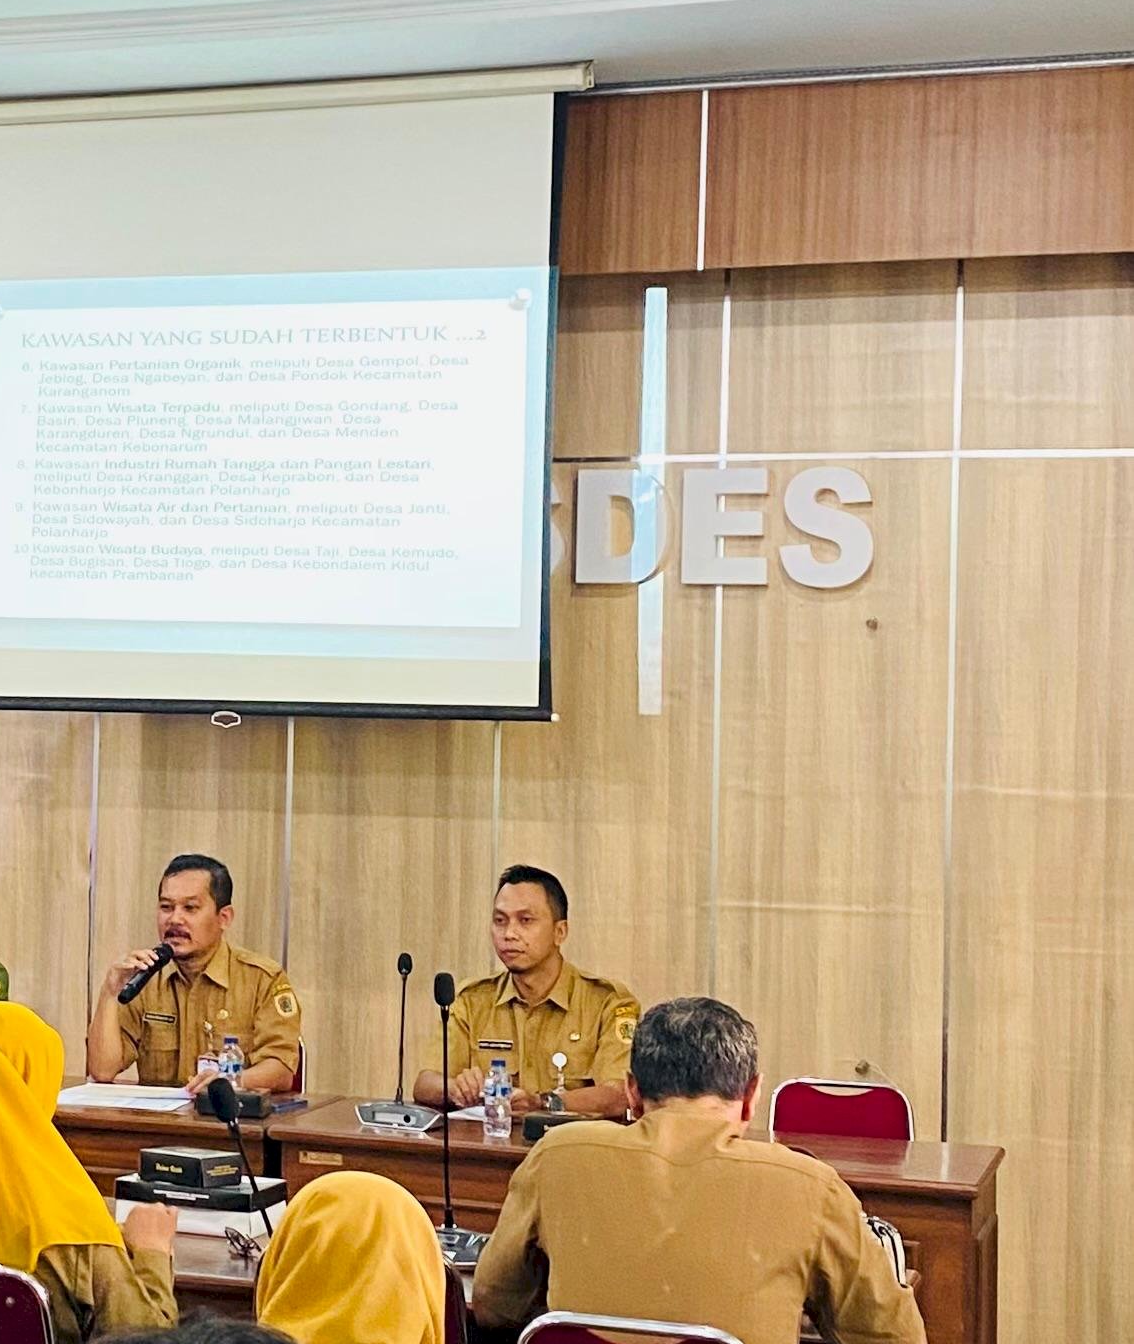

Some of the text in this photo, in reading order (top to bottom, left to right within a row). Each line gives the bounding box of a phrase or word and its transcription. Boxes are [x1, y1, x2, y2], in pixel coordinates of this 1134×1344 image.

[22, 332, 132, 348] KAWASAN
[139, 331, 202, 346] YANG
[210, 329, 293, 345] SUDAH
[300, 326, 447, 343] TERBENTUK
[40, 360, 103, 371] Kawasan
[109, 359, 179, 370] Pertanian
[250, 357, 310, 369] meliputi
[316, 357, 353, 368] Desa
[430, 355, 468, 366] Desa
[93, 373, 128, 383] Desa
[216, 372, 242, 382] dan
[249, 371, 285, 381] Desa
[292, 370, 347, 381] Pondok
[354, 369, 442, 380] Kecamatan
[38, 387, 130, 398] Karanganom
[38, 403, 101, 413] Kawasan
[107, 402, 155, 413] Wisata
[230, 401, 289, 413] meliputi
[295, 401, 332, 411] Desa
[419, 400, 458, 410] Desa
[86, 415, 121, 425] Desa
[196, 415, 232, 425] Desa
[343, 414, 380, 424] Desa
[140, 428, 175, 438] Desa
[258, 427, 285, 438] dan
[292, 427, 329, 438] Desa
[336, 427, 398, 438] Menden
[36, 442, 207, 453] Kecamatan Kebonarum
[35, 459, 99, 469] Kawasan
[105, 459, 159, 469] Industri
[165, 459, 216, 469] Rumah
[224, 459, 274, 471] Tangga
[281, 459, 308, 469] dan
[314, 459, 371, 471] Pangan
[34, 472, 91, 484] meliputi
[97, 472, 132, 482] Desa
[219, 472, 255, 482] Desa
[346, 472, 373, 482] dan
[380, 472, 419, 483] Desa
[34, 485, 290, 497] Kebonharjo Kecamatan Polanharjo
[33, 502, 97, 512] Kawasan
[103, 502, 152, 512] Wisata
[157, 502, 175, 512] Air
[181, 502, 207, 512] dan
[296, 503, 357, 515] meliputi
[364, 503, 402, 514] Desa
[33, 515, 67, 525] Desa
[159, 515, 186, 526] dan
[193, 516, 228, 526] Desa
[235, 516, 306, 528] Sidoharjo
[312, 516, 400, 526] Kecamatan
[550, 466, 875, 589] DES
[32, 527, 108, 539] Polanharjo
[33, 544, 94, 554] Kawasan
[99, 544, 146, 555] Wisata
[211, 545, 268, 557] meliputi
[274, 546, 309, 556] Desa
[349, 547, 386, 557] Desa
[30, 557, 64, 566] Desa
[134, 558, 168, 567] Desa
[220, 558, 246, 568] dan
[252, 558, 287, 568] Desa
[392, 560, 429, 571] Kidul
[30, 569, 193, 580] Kecamatan Prambanan
